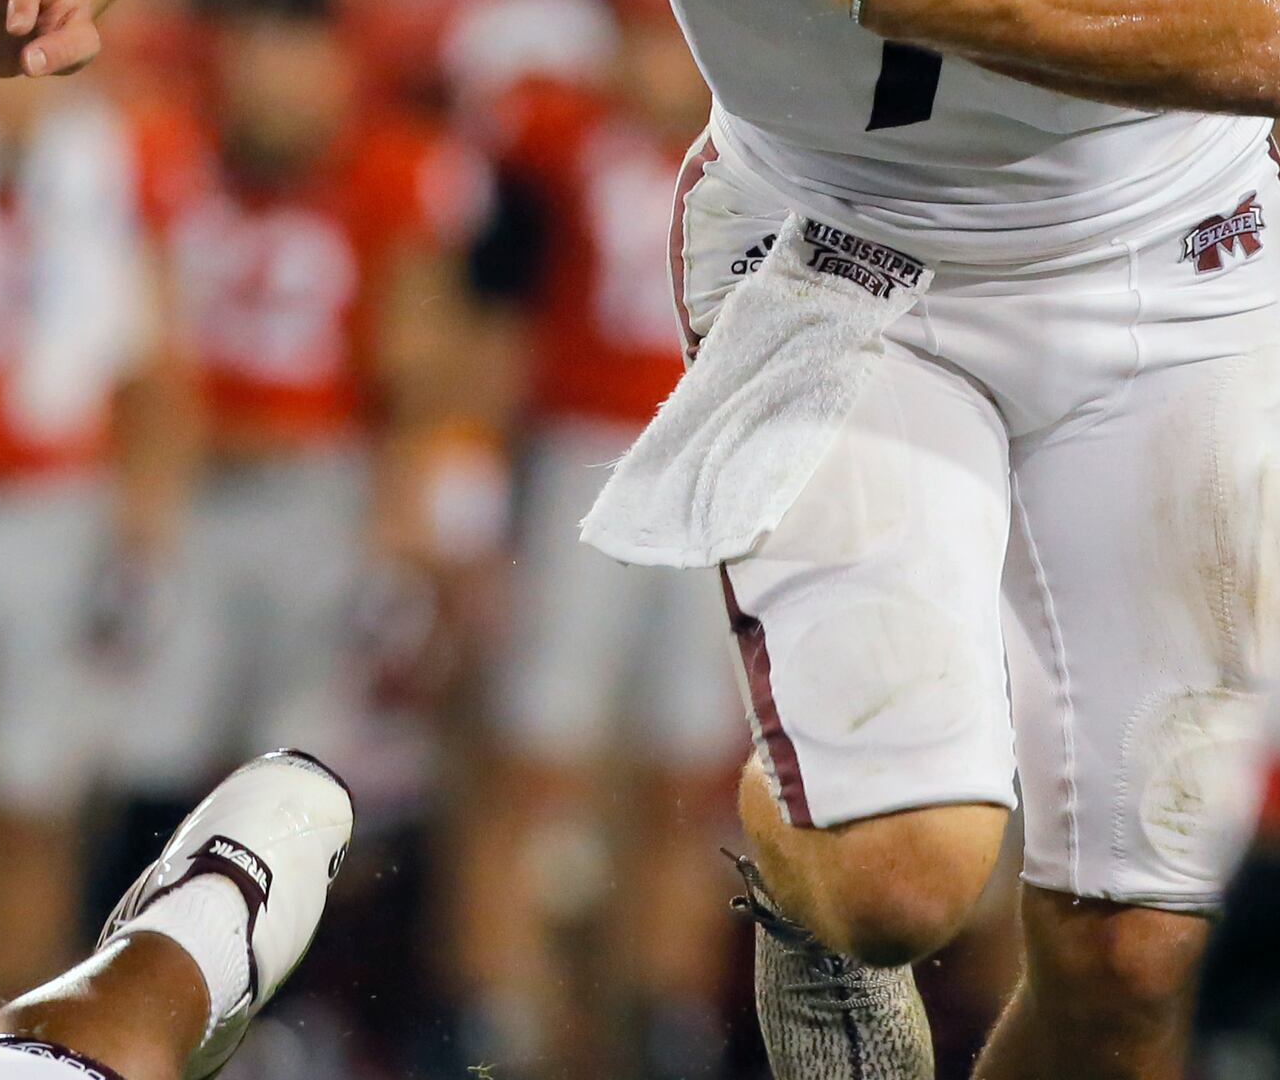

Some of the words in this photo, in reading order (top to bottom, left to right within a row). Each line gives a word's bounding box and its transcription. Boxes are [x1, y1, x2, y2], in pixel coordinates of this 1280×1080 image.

[1199, 215, 1252, 248] STATE
[805, 220, 920, 285] MISSISSIPPI
[826, 258, 879, 293] STATE
